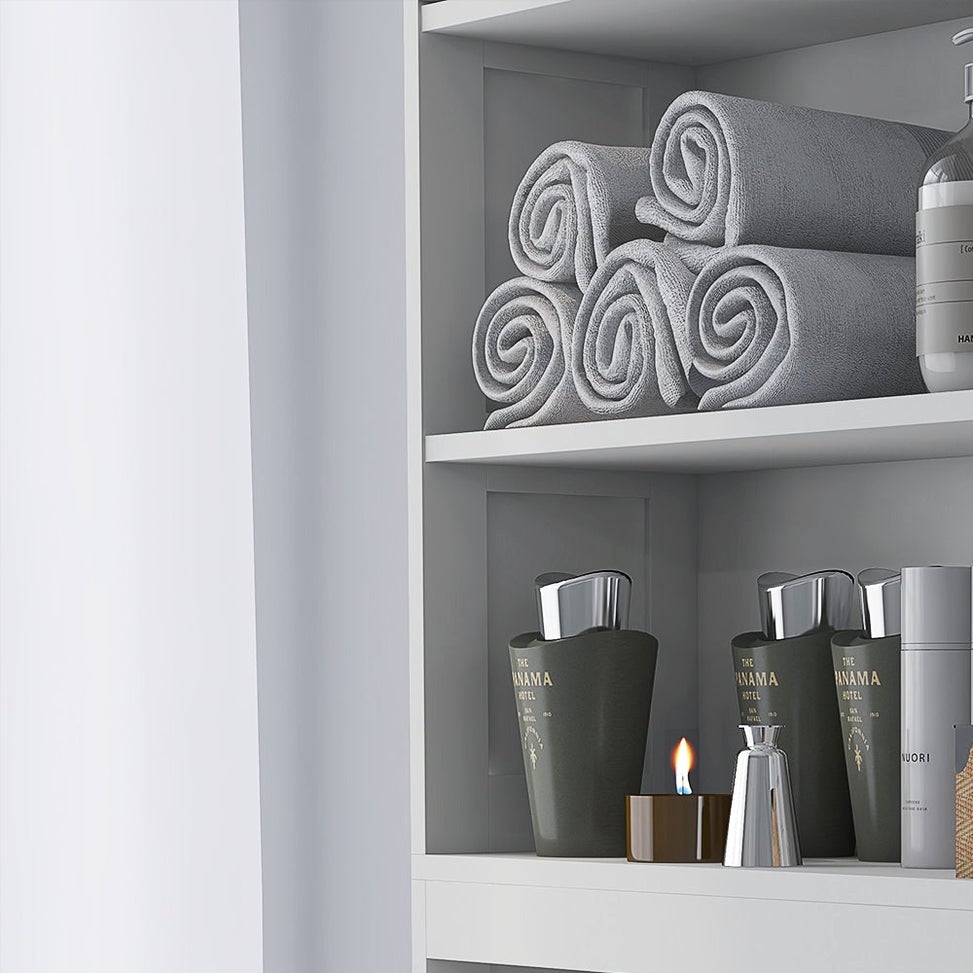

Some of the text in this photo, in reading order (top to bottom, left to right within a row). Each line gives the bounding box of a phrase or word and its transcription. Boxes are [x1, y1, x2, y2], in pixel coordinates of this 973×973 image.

[517, 658, 529, 667] THE
[741, 658, 754, 668] THE
[842, 656, 855, 666] THE
[512, 672, 553, 686] ANAMA
[736, 672, 779, 686] ANAMA
[835, 671, 881, 685] ANAMA
[518, 691, 536, 700] HOTEL
[742, 691, 761, 701] HOTEL
[842, 690, 862, 700] HOTEL
